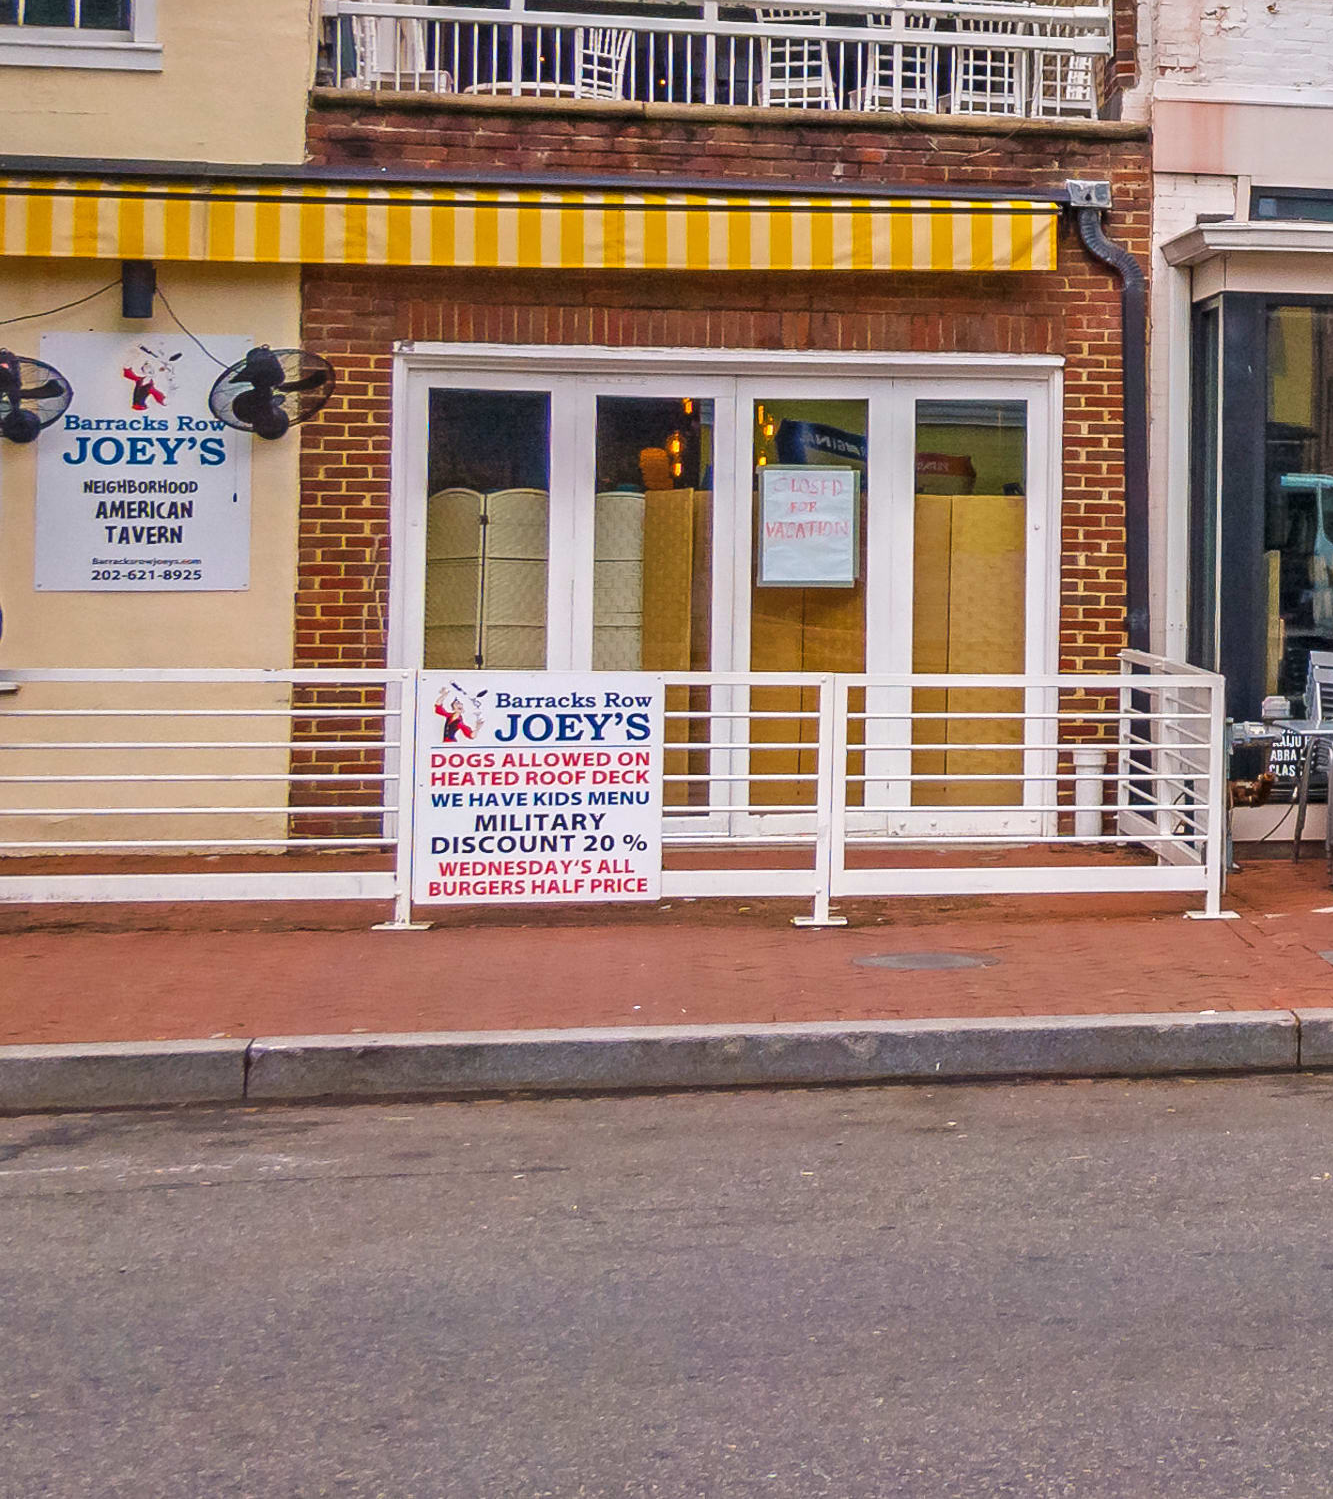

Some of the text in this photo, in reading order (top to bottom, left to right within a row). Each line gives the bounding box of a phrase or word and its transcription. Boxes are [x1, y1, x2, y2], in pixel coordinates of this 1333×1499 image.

[64, 416, 228, 432] Barracks Row
[63, 437, 226, 466] JOEY'S
[83, 480, 198, 495] NEIGHBORHOOD
[95, 500, 194, 520] AMERICAN
[789, 501, 817, 513] FOR
[105, 526, 183, 545] TAVERN
[766, 521, 849, 539] VACATION
[91, 570, 202, 581] 202-621-8925
[495, 692, 652, 708] Barracks Row
[495, 712, 651, 742] JOEY'S
[431, 751, 650, 768] DOGS ALLOWED ON
[1270, 749, 1297, 761] ABRA
[431, 770, 649, 786] HEATED ROOF DECK
[431, 791, 650, 807] WE HAVE KIDS MENU
[474, 812, 606, 832] MILITARY
[431, 834, 648, 854] DISCOUNT 20 %
[438, 859, 635, 877] WEDNESDAY'S ALL
[428, 878, 648, 897] BURGERS HALF PRICE
